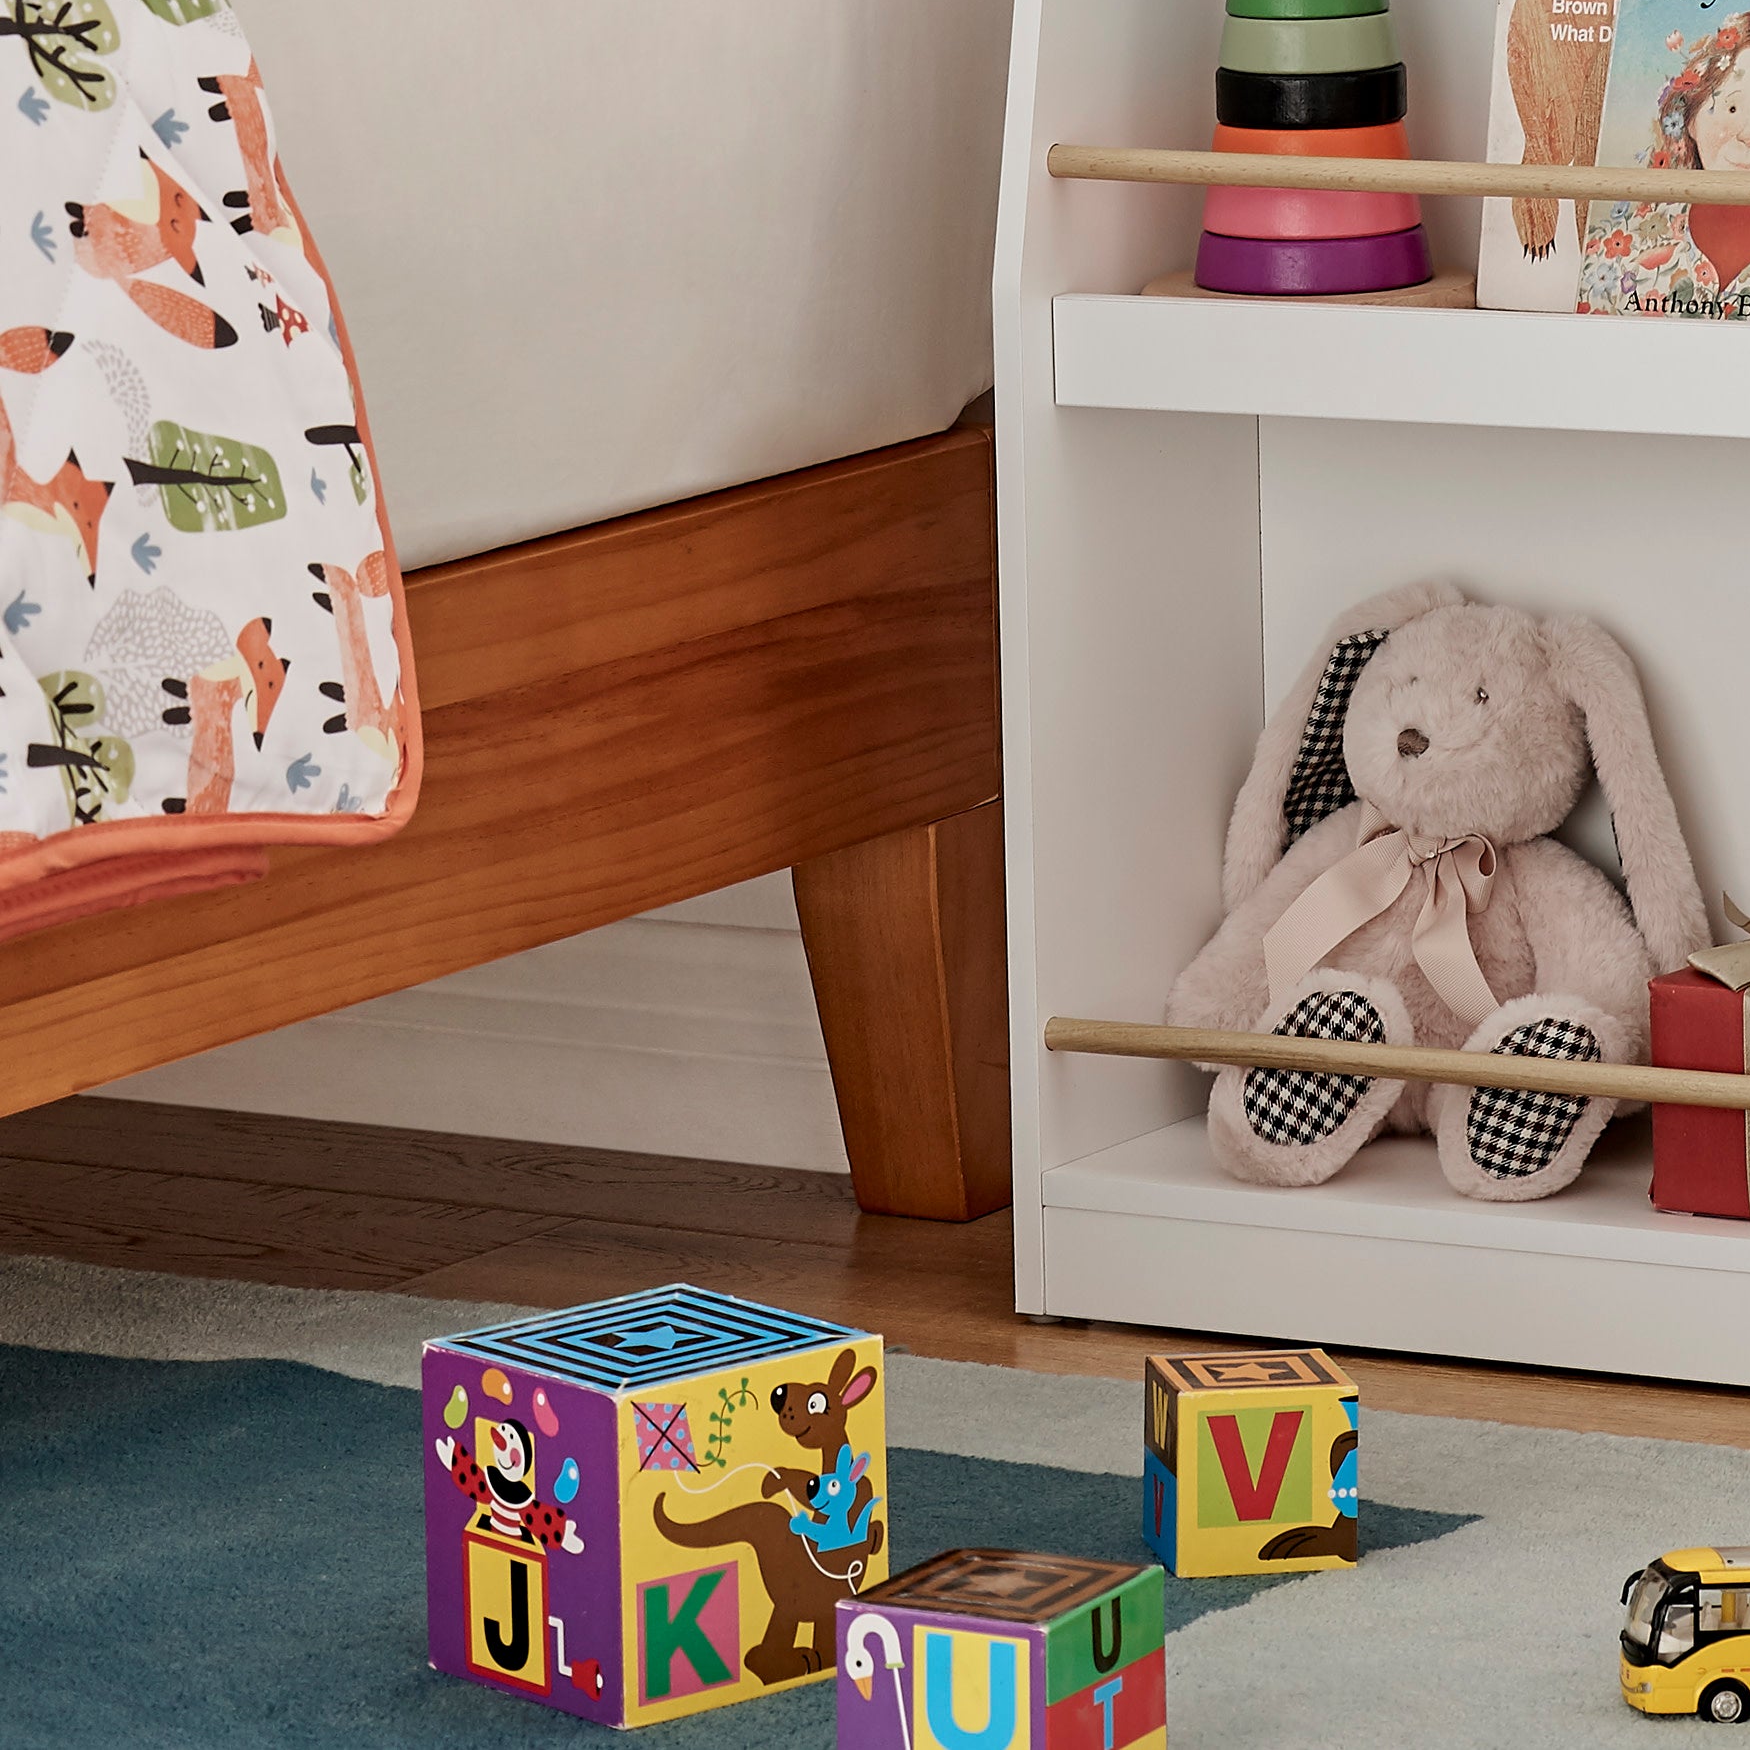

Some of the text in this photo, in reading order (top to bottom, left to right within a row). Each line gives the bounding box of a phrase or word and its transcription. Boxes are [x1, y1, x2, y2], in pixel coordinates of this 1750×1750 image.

[1550, 23, 1613, 43] What D
[1624, 290, 1728, 319] Anthony
[1152, 1379, 1169, 1450] W
[1206, 1410, 1304, 1522] V
[1153, 1473, 1165, 1538] V
[484, 1559, 530, 1671] J
[644, 1569, 734, 1700] K
[1091, 1596, 1121, 1674] U
[925, 1632, 1017, 1750] U
[1094, 1676, 1123, 1750] T
